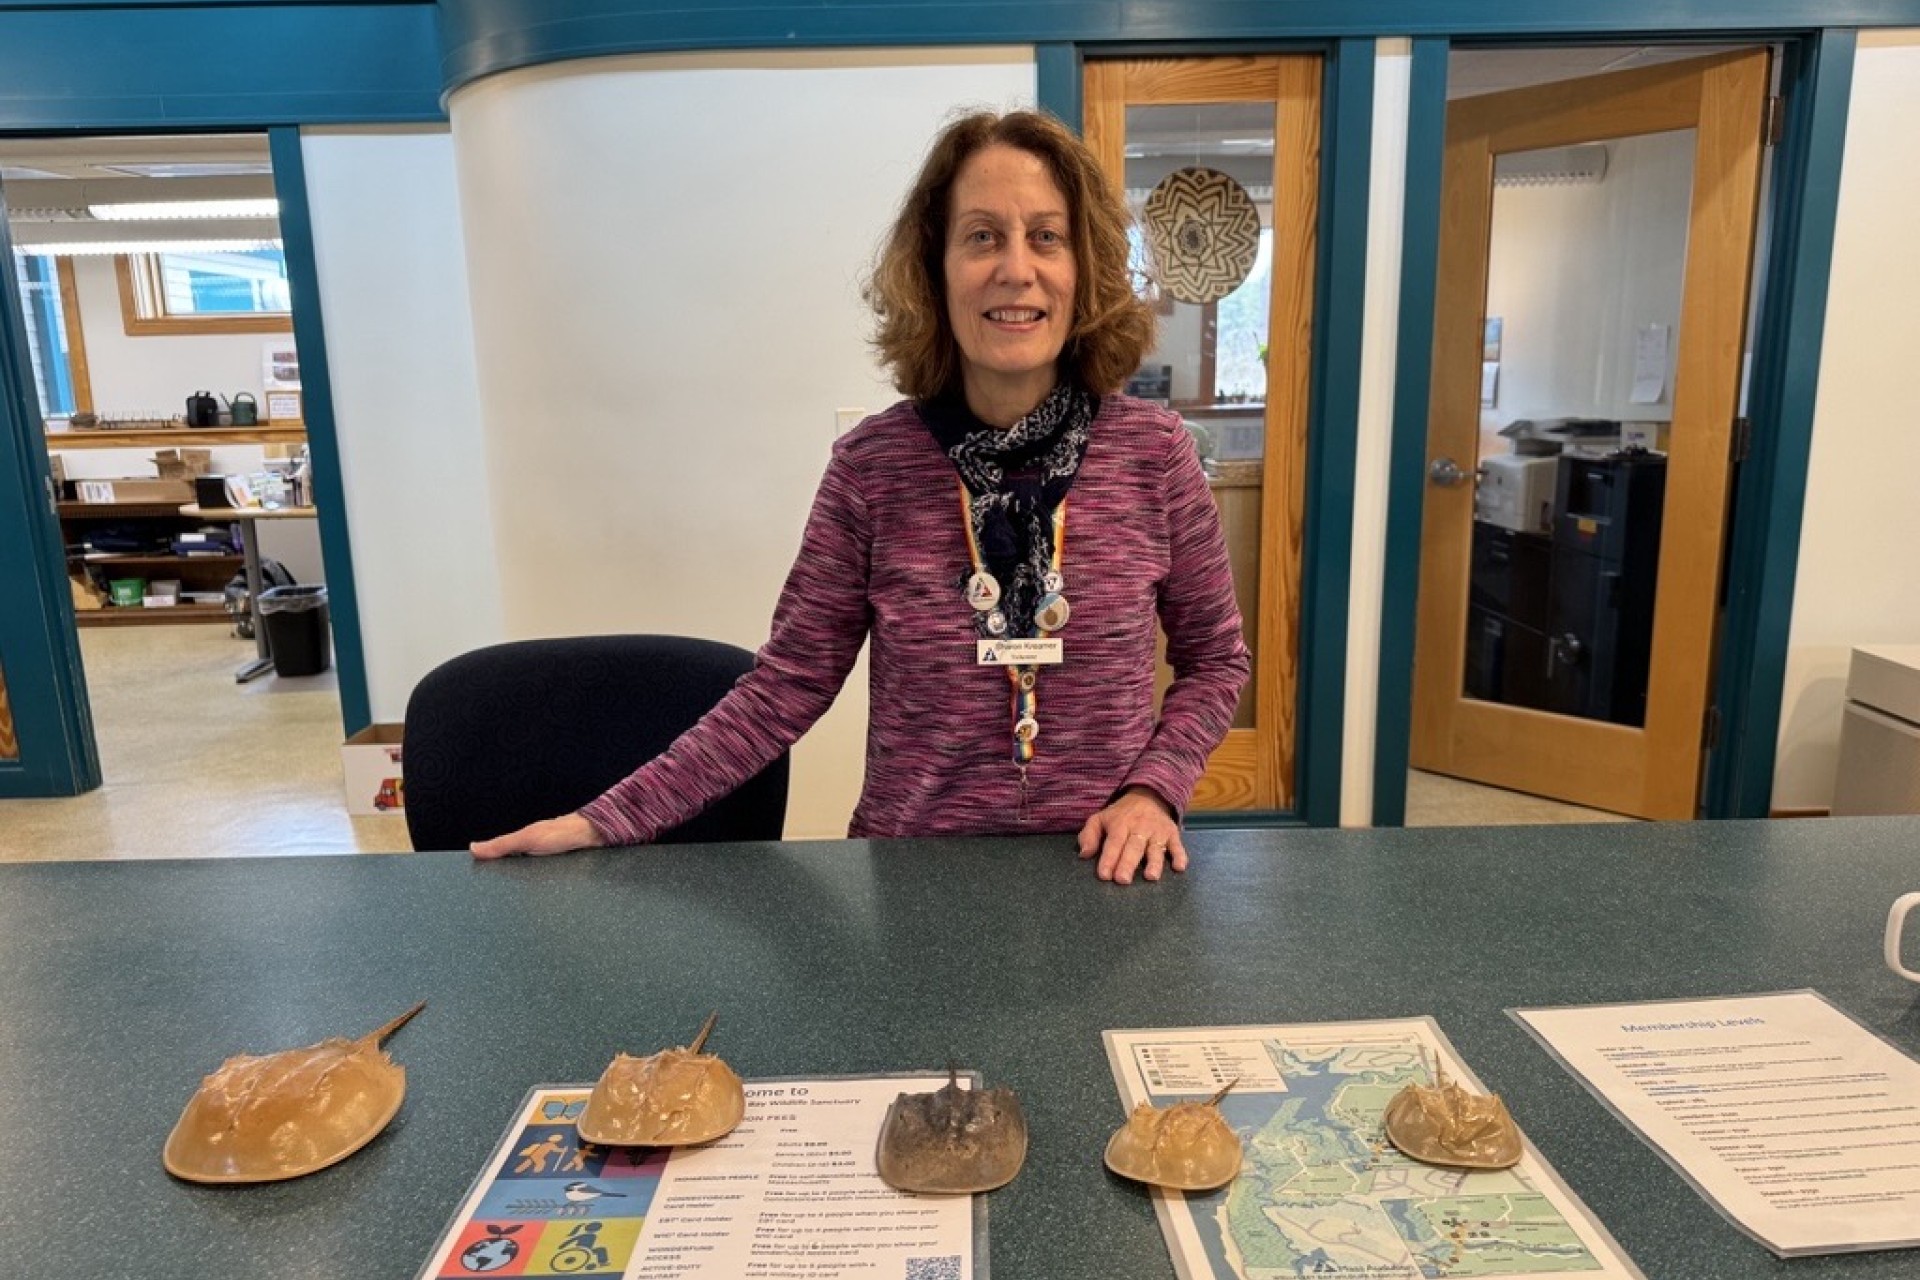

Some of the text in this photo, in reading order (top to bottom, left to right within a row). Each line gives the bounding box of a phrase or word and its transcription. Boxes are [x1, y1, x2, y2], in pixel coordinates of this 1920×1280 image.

[1620, 1016, 1766, 1033] Membership Levels
[790, 1087, 808, 1096] to
